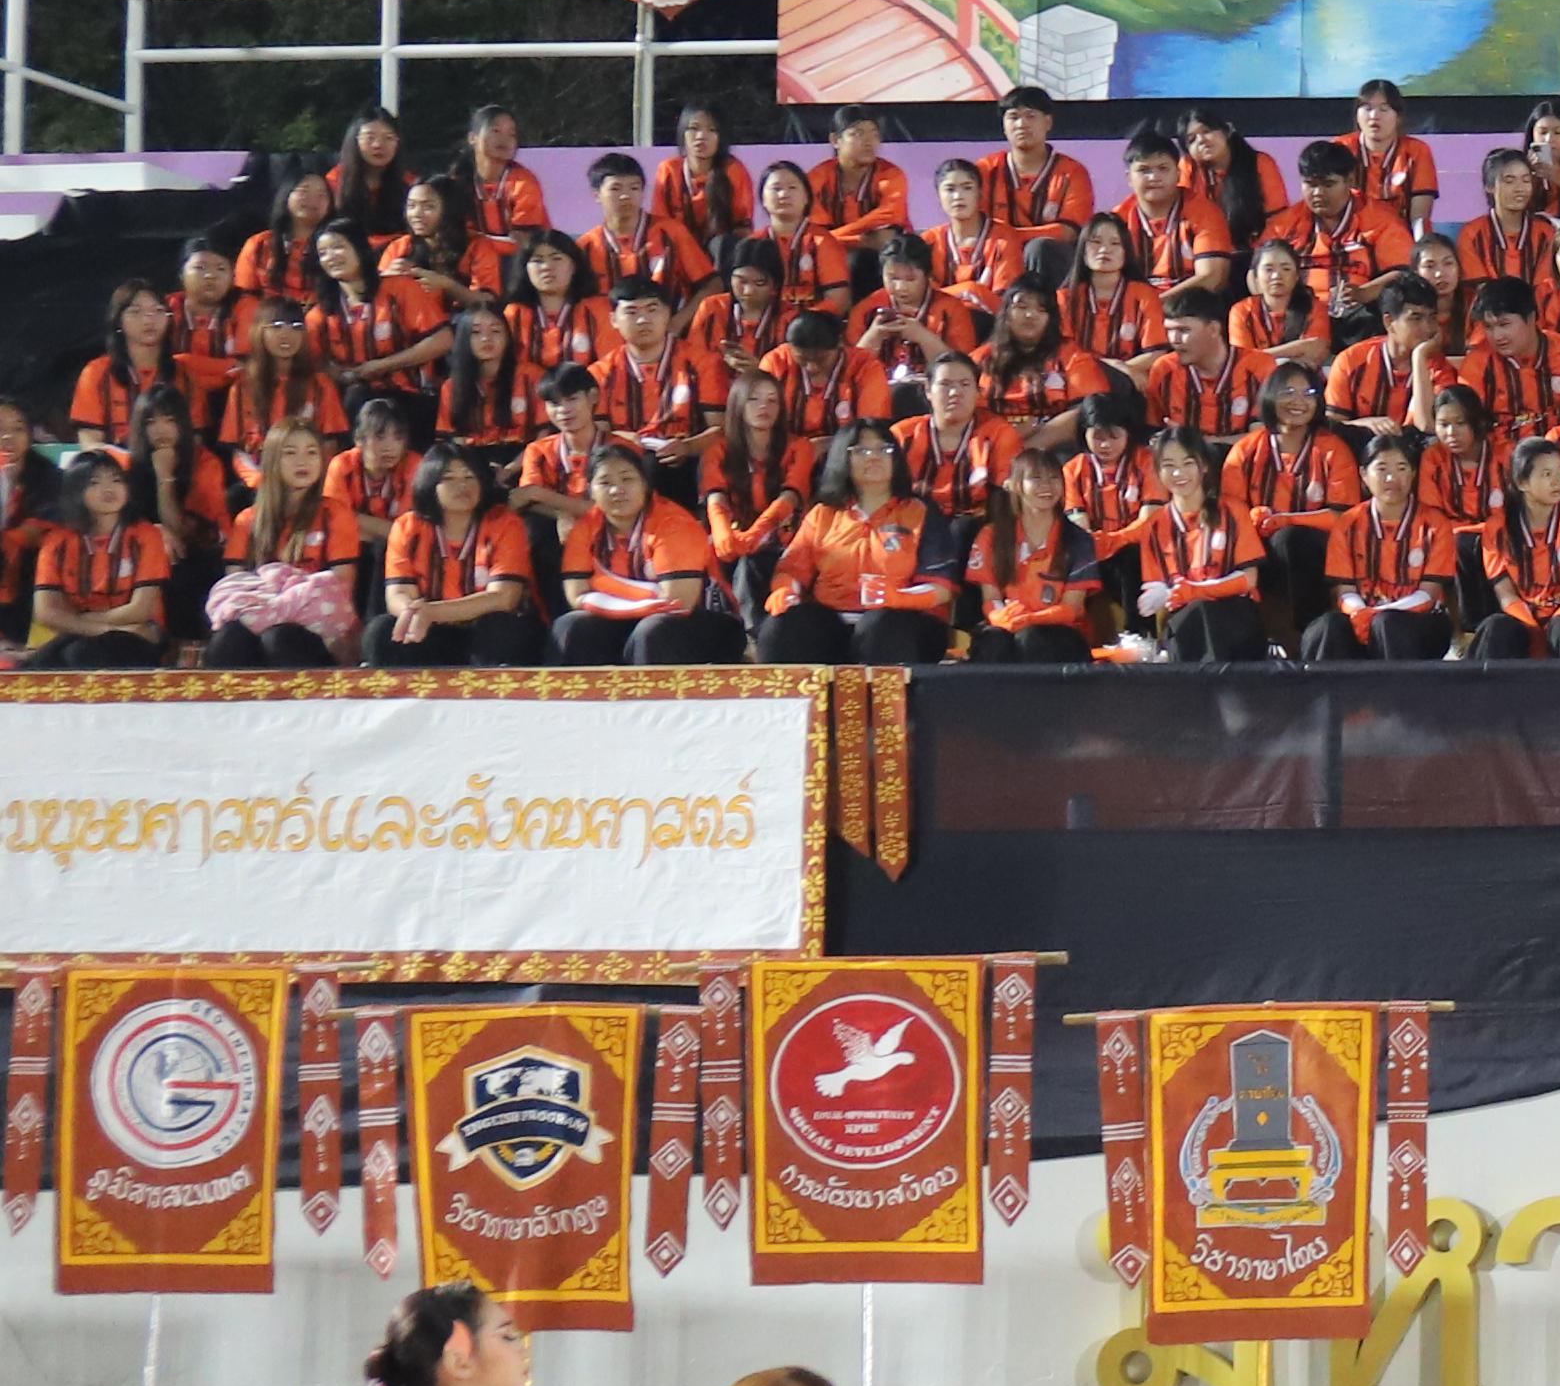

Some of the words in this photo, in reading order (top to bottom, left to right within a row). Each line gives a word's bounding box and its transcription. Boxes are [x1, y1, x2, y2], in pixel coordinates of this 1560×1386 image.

[521, 1109, 588, 1134] PROGRAM
[789, 1105, 834, 1151] SOCIAL
[779, 1163, 960, 1211] การพัฒนาสังคม
[1189, 1232, 1331, 1282] วิชาภาษาไทย
